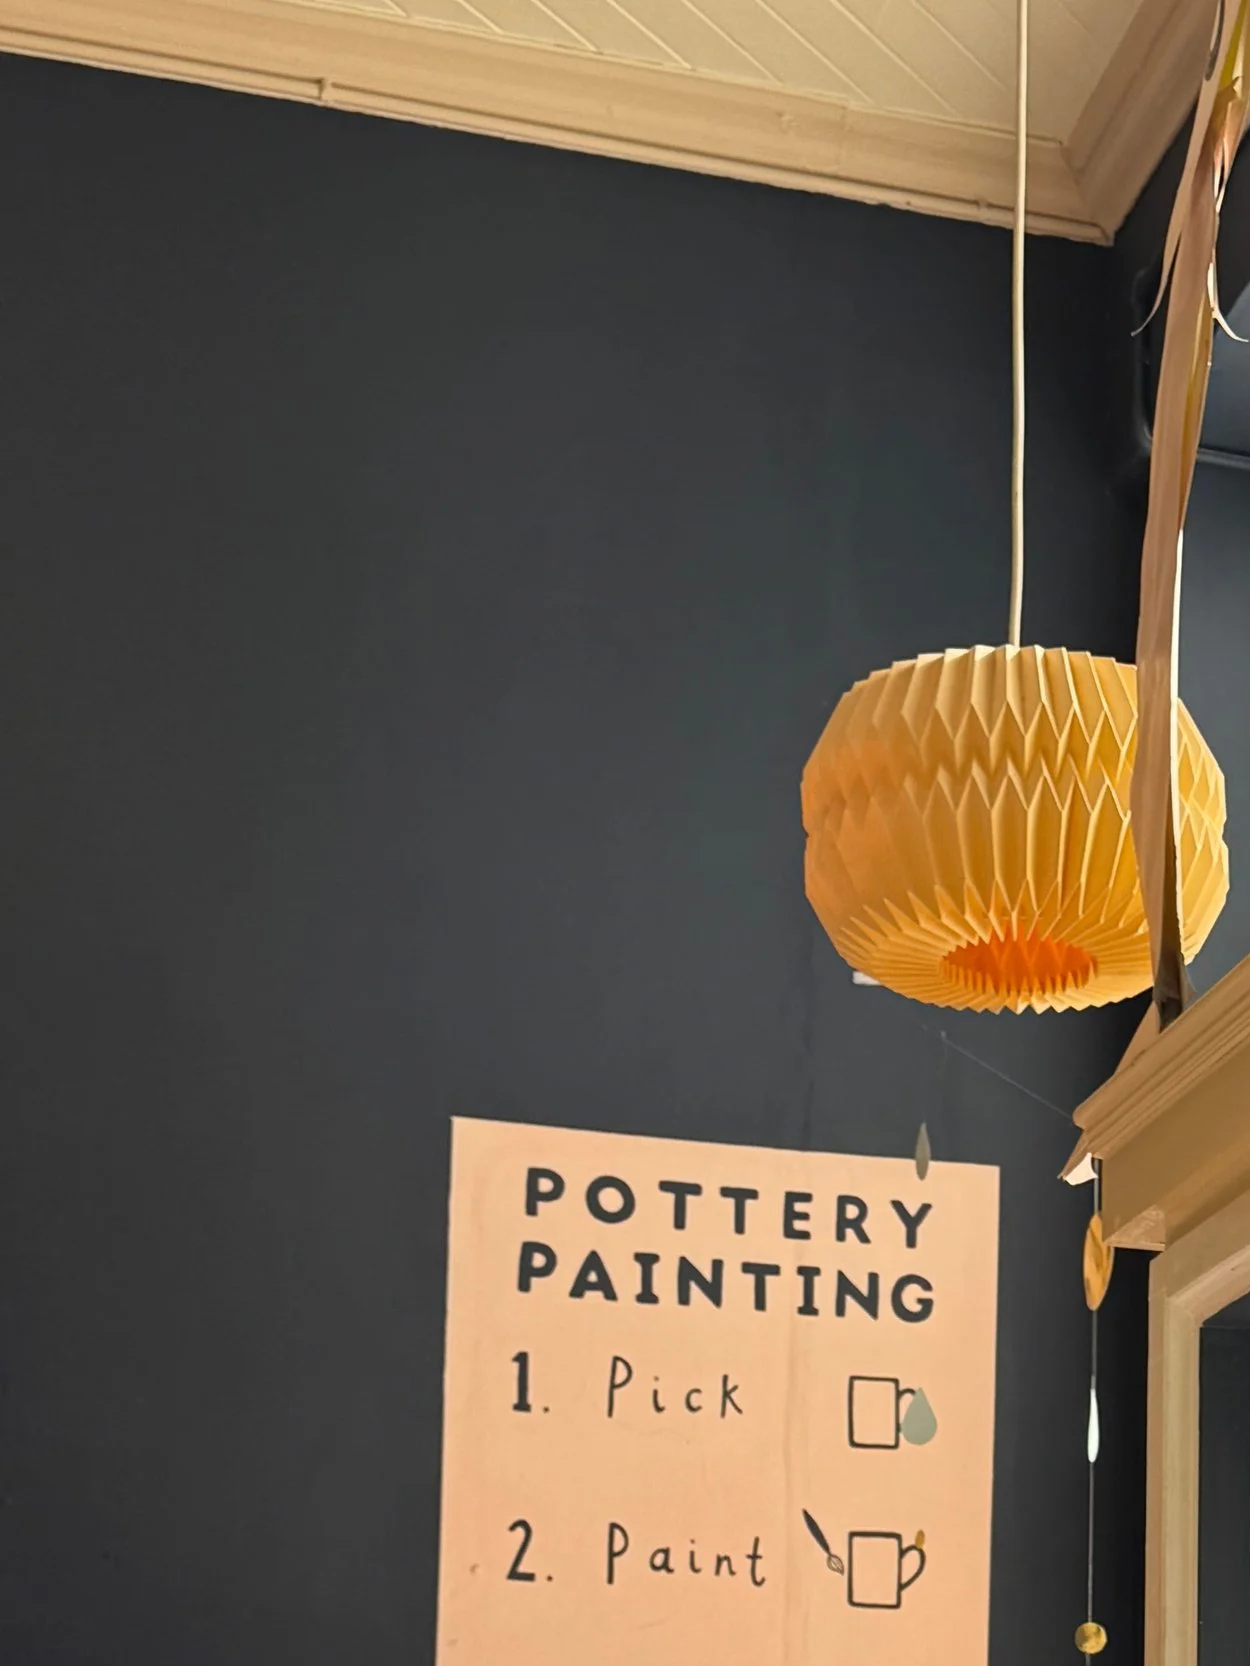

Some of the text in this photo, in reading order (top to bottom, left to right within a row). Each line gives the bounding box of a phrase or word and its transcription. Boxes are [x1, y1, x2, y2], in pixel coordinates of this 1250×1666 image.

[526, 1167, 932, 1249] POTTERY
[518, 1242, 934, 1323] PAINTING
[512, 1351, 743, 1418] 1. Pick
[506, 1519, 766, 1587] 2. Paint
